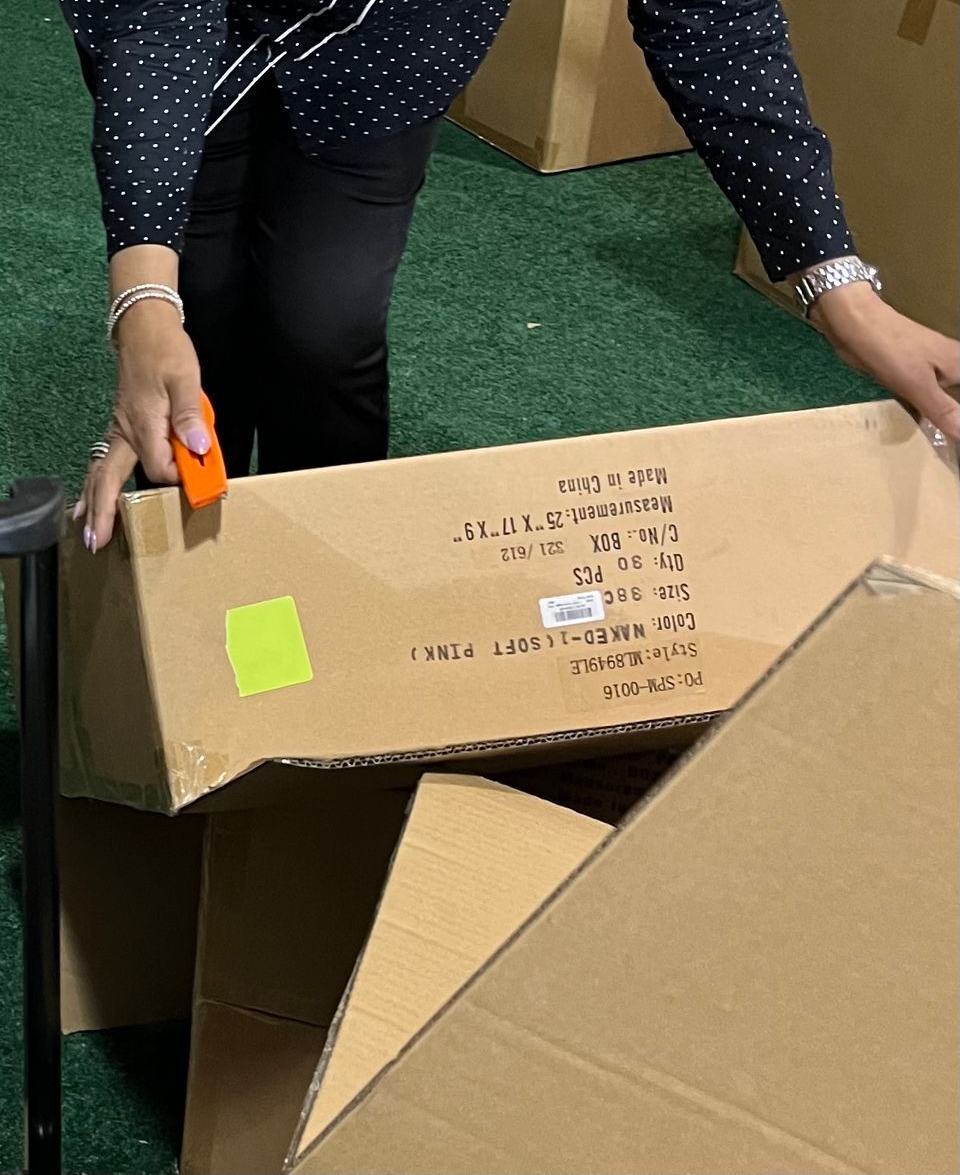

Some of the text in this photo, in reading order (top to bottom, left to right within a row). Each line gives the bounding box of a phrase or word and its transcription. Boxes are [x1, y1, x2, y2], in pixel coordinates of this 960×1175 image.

[558, 467, 668, 495] Made in China
[590, 531, 621, 553] BOX
[654, 553, 685, 572] Qty:
[572, 565, 603, 587] PCS
[653, 582, 691, 601] Size:
[652, 612, 697, 631] Color:
[411, 642, 475, 662] PINK)
